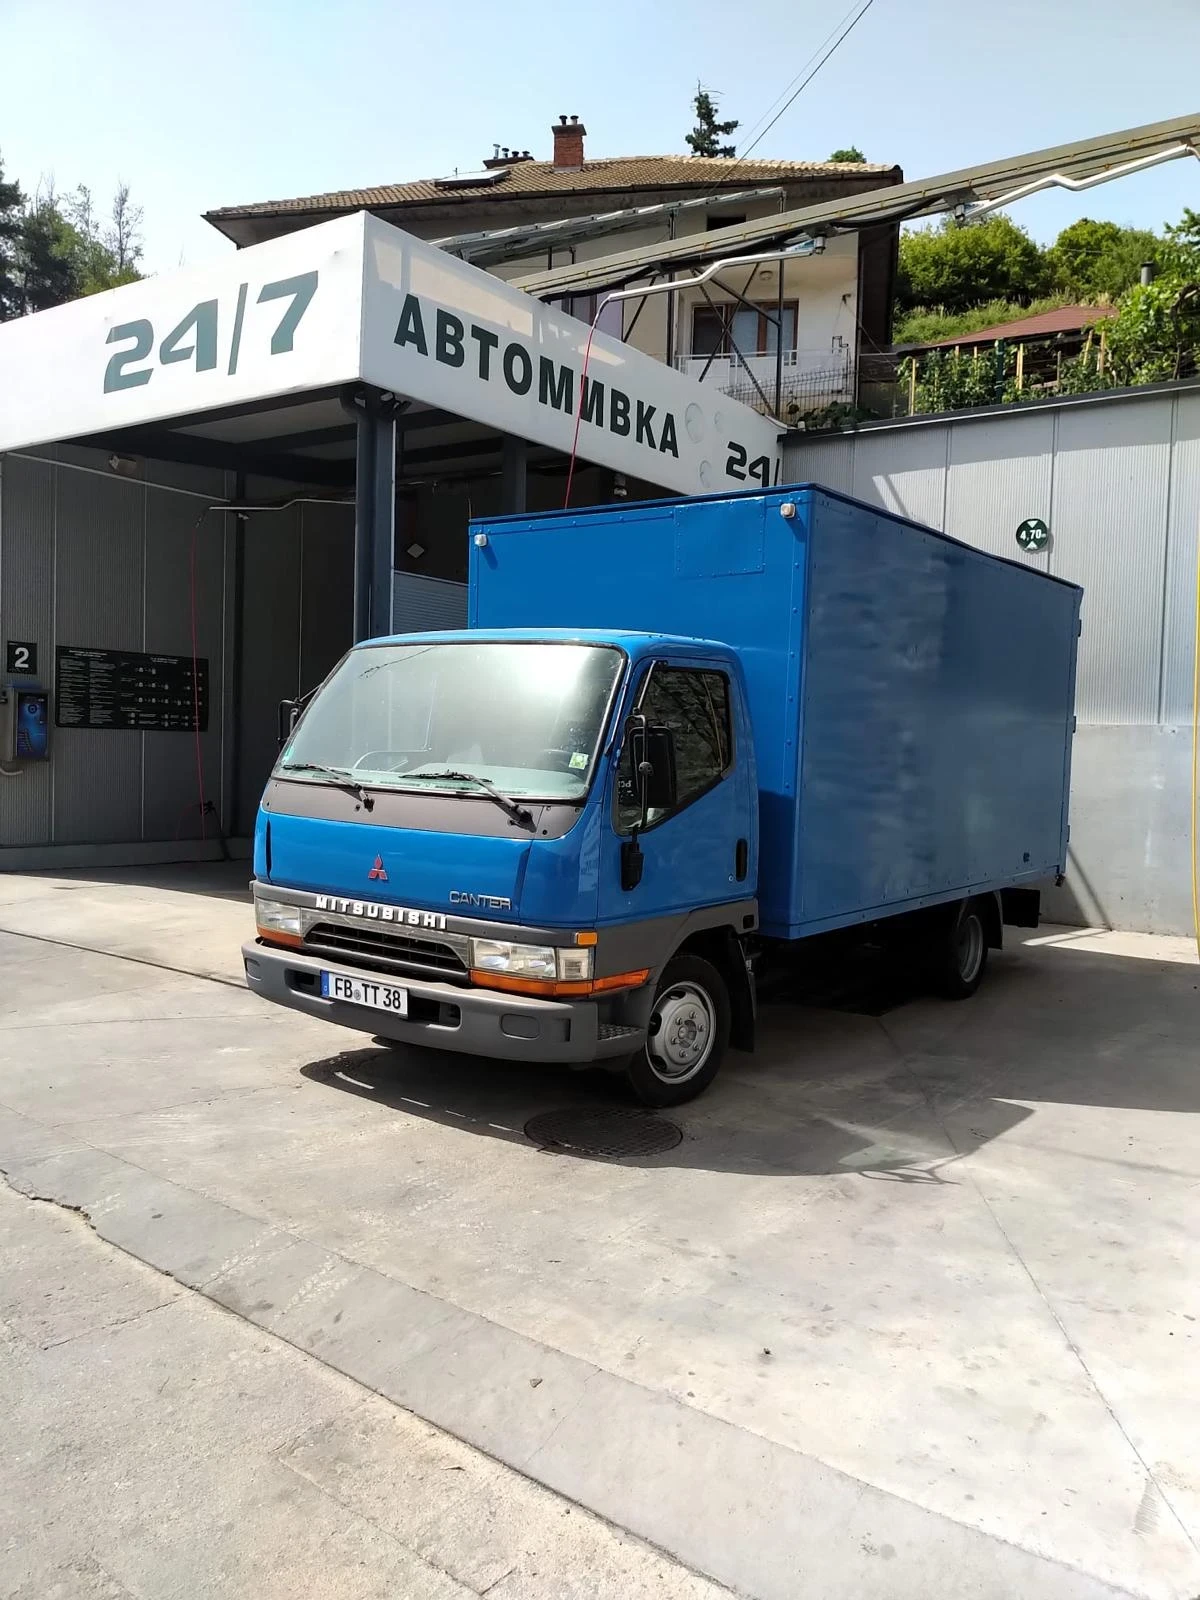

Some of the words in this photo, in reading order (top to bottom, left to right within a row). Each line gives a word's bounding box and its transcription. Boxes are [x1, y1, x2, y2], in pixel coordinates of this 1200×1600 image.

[103, 270, 319, 394] 24/7
[393, 293, 680, 459] АВТОМИВКА
[15, 647, 29, 668] 2
[315, 895, 448, 929] MITSUBISHI
[450, 890, 511, 910] CANTER
[335, 977, 353, 998] FB
[362, 983, 379, 1005] TT
[383, 987, 401, 1010] 38
